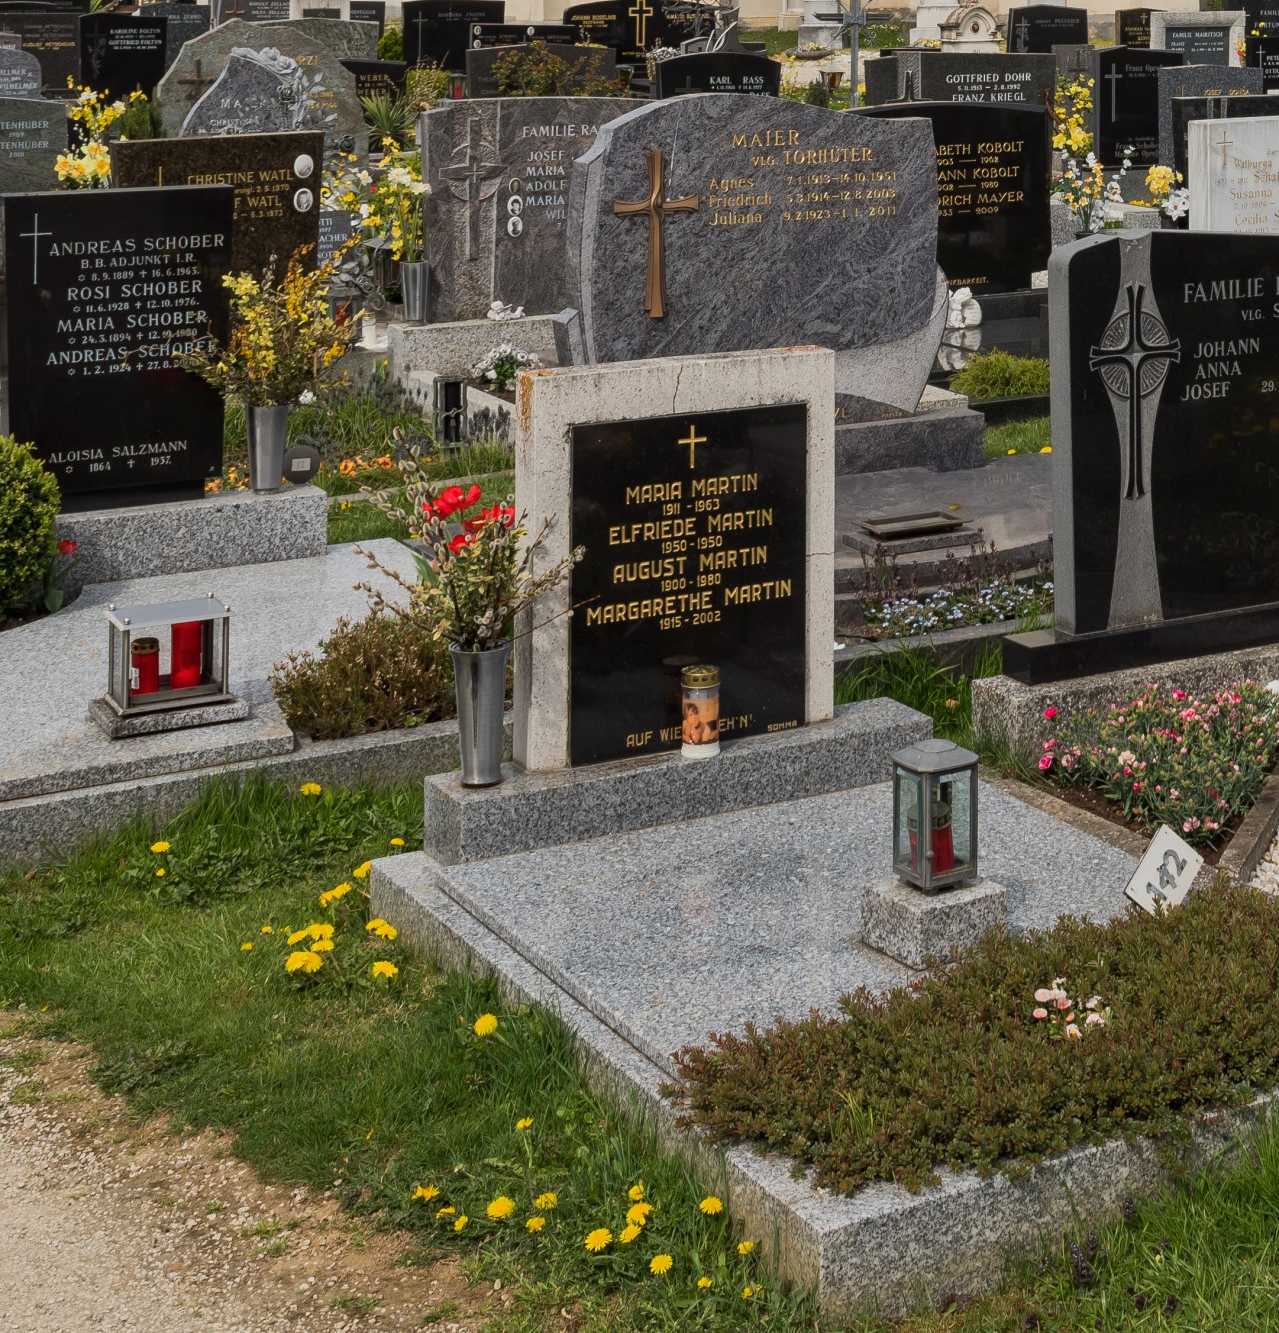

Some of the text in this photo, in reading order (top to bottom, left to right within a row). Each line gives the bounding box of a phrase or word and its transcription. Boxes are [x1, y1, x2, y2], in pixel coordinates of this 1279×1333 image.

[1125, 63, 1144, 72] Franz
[360, 74, 389, 82] WEBER
[709, 76, 764, 85] KARL RASS
[945, 72, 1032, 84] GOTTFRIED DOHR
[952, 92, 1026, 103] FRANZ KRIEGL
[523, 124, 576, 138] FAMILIE
[731, 129, 800, 148] MAIER
[783, 146, 873, 165] TORHÜTER
[977, 141, 1025, 154] KOBOLT
[527, 150, 566, 162] JOSEF
[187, 169, 294, 186] CHRISTINE WATL
[525, 165, 565, 177] MARIA
[973, 166, 1020, 179] KOBOLT
[525, 179, 568, 192] ADOLF
[709, 176, 754, 192] Agnes
[247, 195, 282, 207] WATL
[525, 194, 566, 207] MARIA
[708, 192, 772, 208] Friedrich
[977, 191, 1024, 204] MAYER
[1229, 188, 1273, 201] Susanna
[709, 209, 763, 226] Juliana
[975, 206, 999, 215] 2009
[1234, 213, 1268, 227] Cecilia
[49, 234, 225, 257] ANDREAS SCHOBER
[109, 254, 171, 268] ADJUNKT
[67, 279, 203, 301] ROSI SCHOBER
[1183, 277, 1265, 303] FAMILIE
[57, 310, 209, 333] MARIA SCHOBER
[46, 346, 128, 365] ANDREAS
[1193, 336, 1261, 360] JOHANN
[1194, 359, 1243, 381] ANNA
[1181, 381, 1232, 402] JOSEF
[48, 440, 188, 464] ALOISIA SALZMANN
[89, 462, 112, 473] 1864
[625, 472, 759, 505] MARIA MARTIN
[608, 507, 774, 546] ELFRIEDE MARTIN
[612, 545, 768, 584] AUGUST MARTIN
[586, 578, 792, 627] MARGARETHE MARTIN
[767, 719, 798, 733] SOMMA
[626, 730, 654, 749] AUF
[1145, 848, 1188, 902] 142
